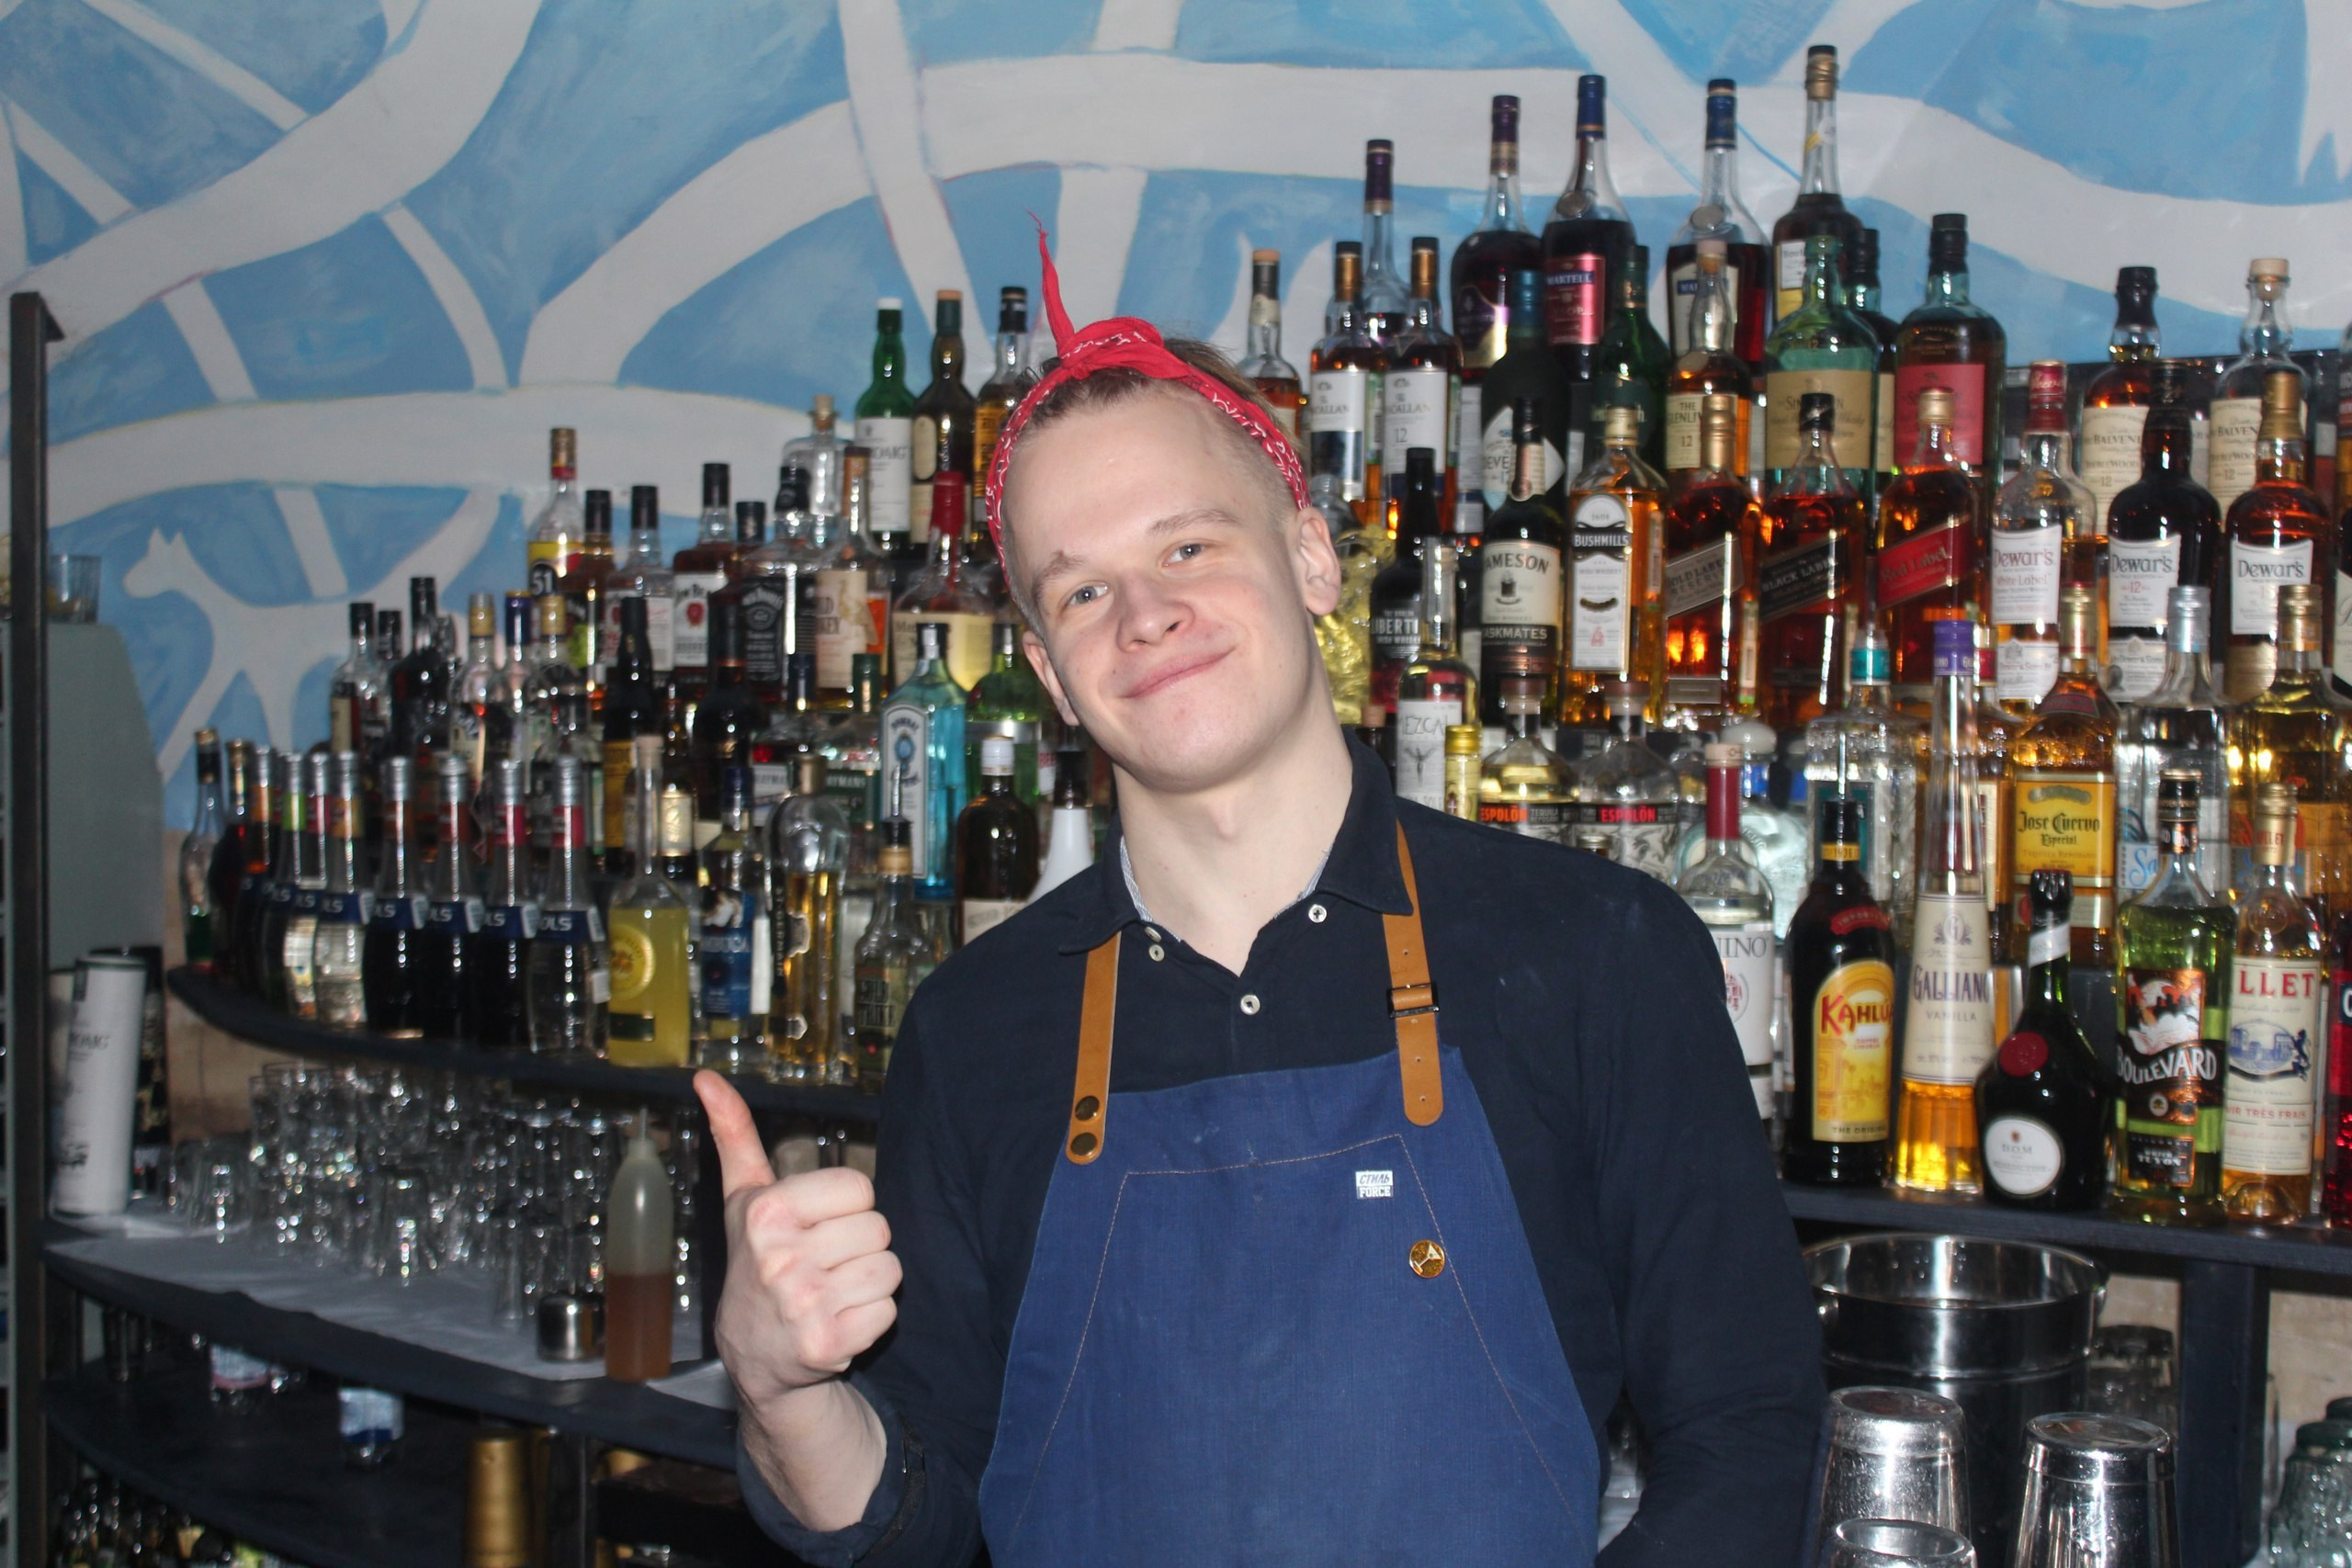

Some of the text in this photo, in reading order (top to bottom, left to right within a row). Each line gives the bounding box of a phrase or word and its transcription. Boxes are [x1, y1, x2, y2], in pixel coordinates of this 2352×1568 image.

[1547, 272, 1592, 285] MARTELL
[1679, 402, 1696, 411] THE
[1668, 412, 1701, 424] LENLI
[1395, 428, 1408, 443] 12
[1680, 435, 1693, 448] 12
[2094, 434, 2141, 446] BALVENI
[2224, 468, 2235, 480] 12
[2101, 476, 2113, 488] 12
[1574, 535, 1630, 547] BUSHMILLS
[1484, 553, 1550, 575] AMESON
[1994, 547, 2054, 568] Dewar's
[2111, 554, 2174, 573] Dewar's
[1695, 558, 1725, 579] LABE
[2238, 559, 2304, 578] Dewar's
[532, 569, 553, 595] 51
[1762, 571, 1799, 591] BLACK
[2131, 581, 2142, 593] 12
[2018, 811, 2100, 834] Jose Cuervo
[1927, 1011, 1976, 1022] VANILLA
[2117, 1044, 2217, 1085] BOULEVARD
[2245, 1107, 2276, 1119] TRÈS
[2278, 1110, 2306, 1120] FRAIS
[1360, 1173, 1390, 1185] СТИЛЬ
[1360, 1186, 1391, 1199] FORCE
